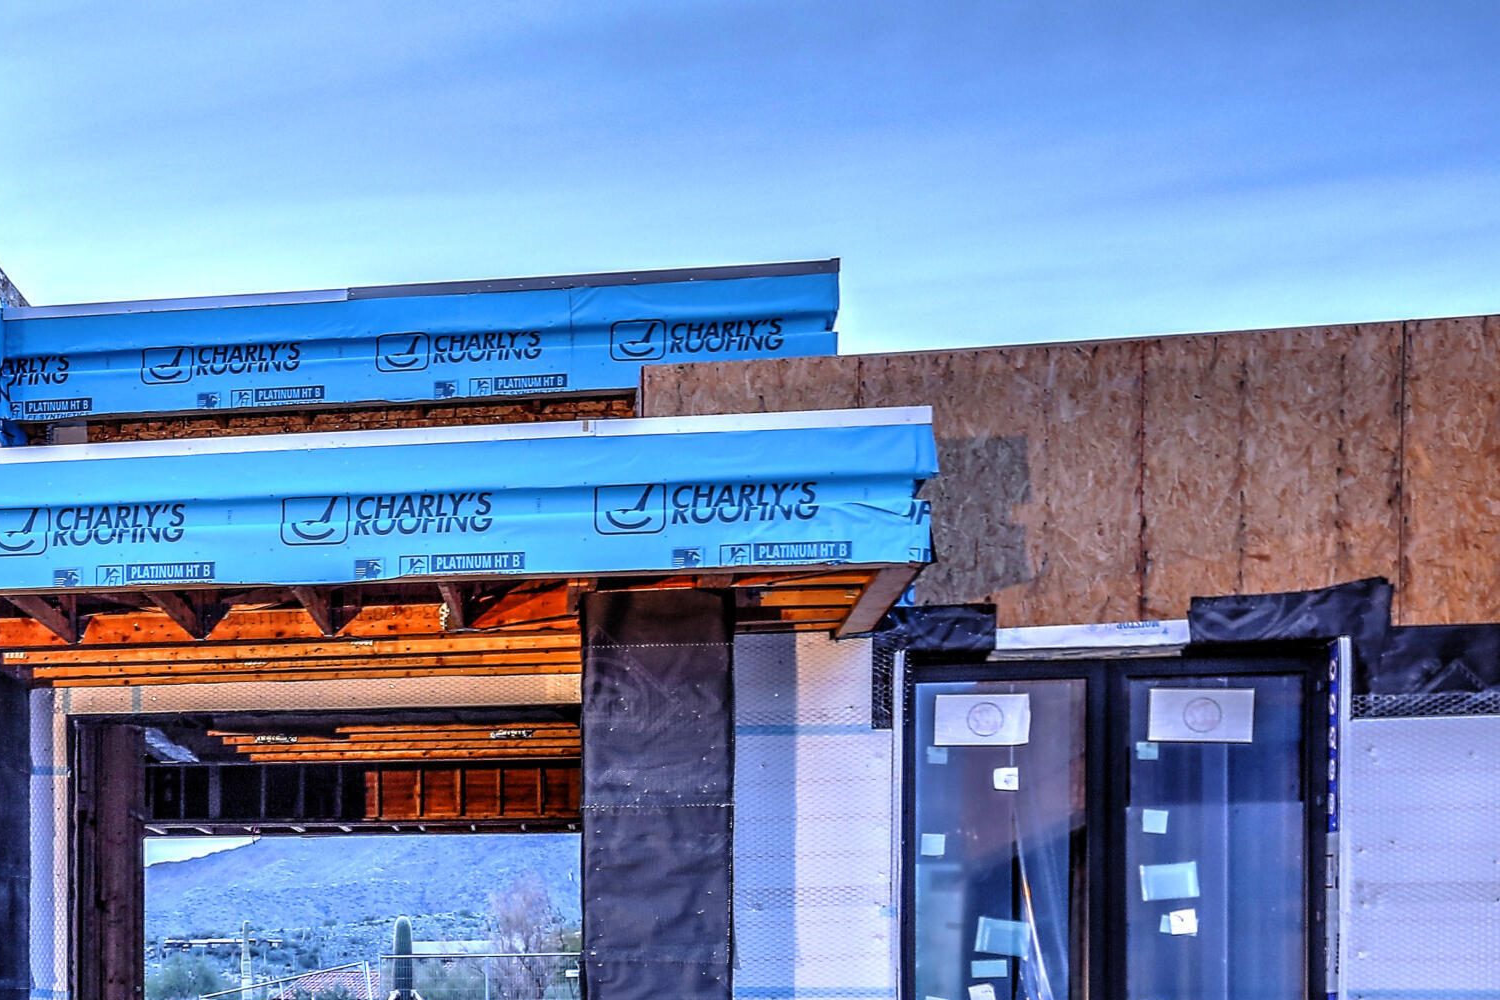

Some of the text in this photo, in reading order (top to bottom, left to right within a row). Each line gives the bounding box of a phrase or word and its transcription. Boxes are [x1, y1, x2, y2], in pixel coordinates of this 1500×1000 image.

[671, 318, 782, 340] CHARLY'S
[434, 330, 542, 352] CHARLY'S
[670, 335, 783, 354] ROOFING
[198, 342, 301, 364] CHARLY'S
[0, 355, 70, 377] ARLY'S
[498, 376, 564, 389] PLATINUM HT B
[258, 387, 321, 401] PLATINUM HT B
[28, 400, 89, 413] PLATINUM HT B
[671, 481, 817, 508] CHARLY'S
[56, 503, 186, 531] CHARLY'S
[355, 492, 493, 520] CHARLY'S
[671, 503, 820, 525] ROOFING
[436, 553, 520, 570] PLATINUM HT B
[759, 543, 848, 559] PLATINUM HT B
[131, 564, 211, 579] PLATINUM HT B
